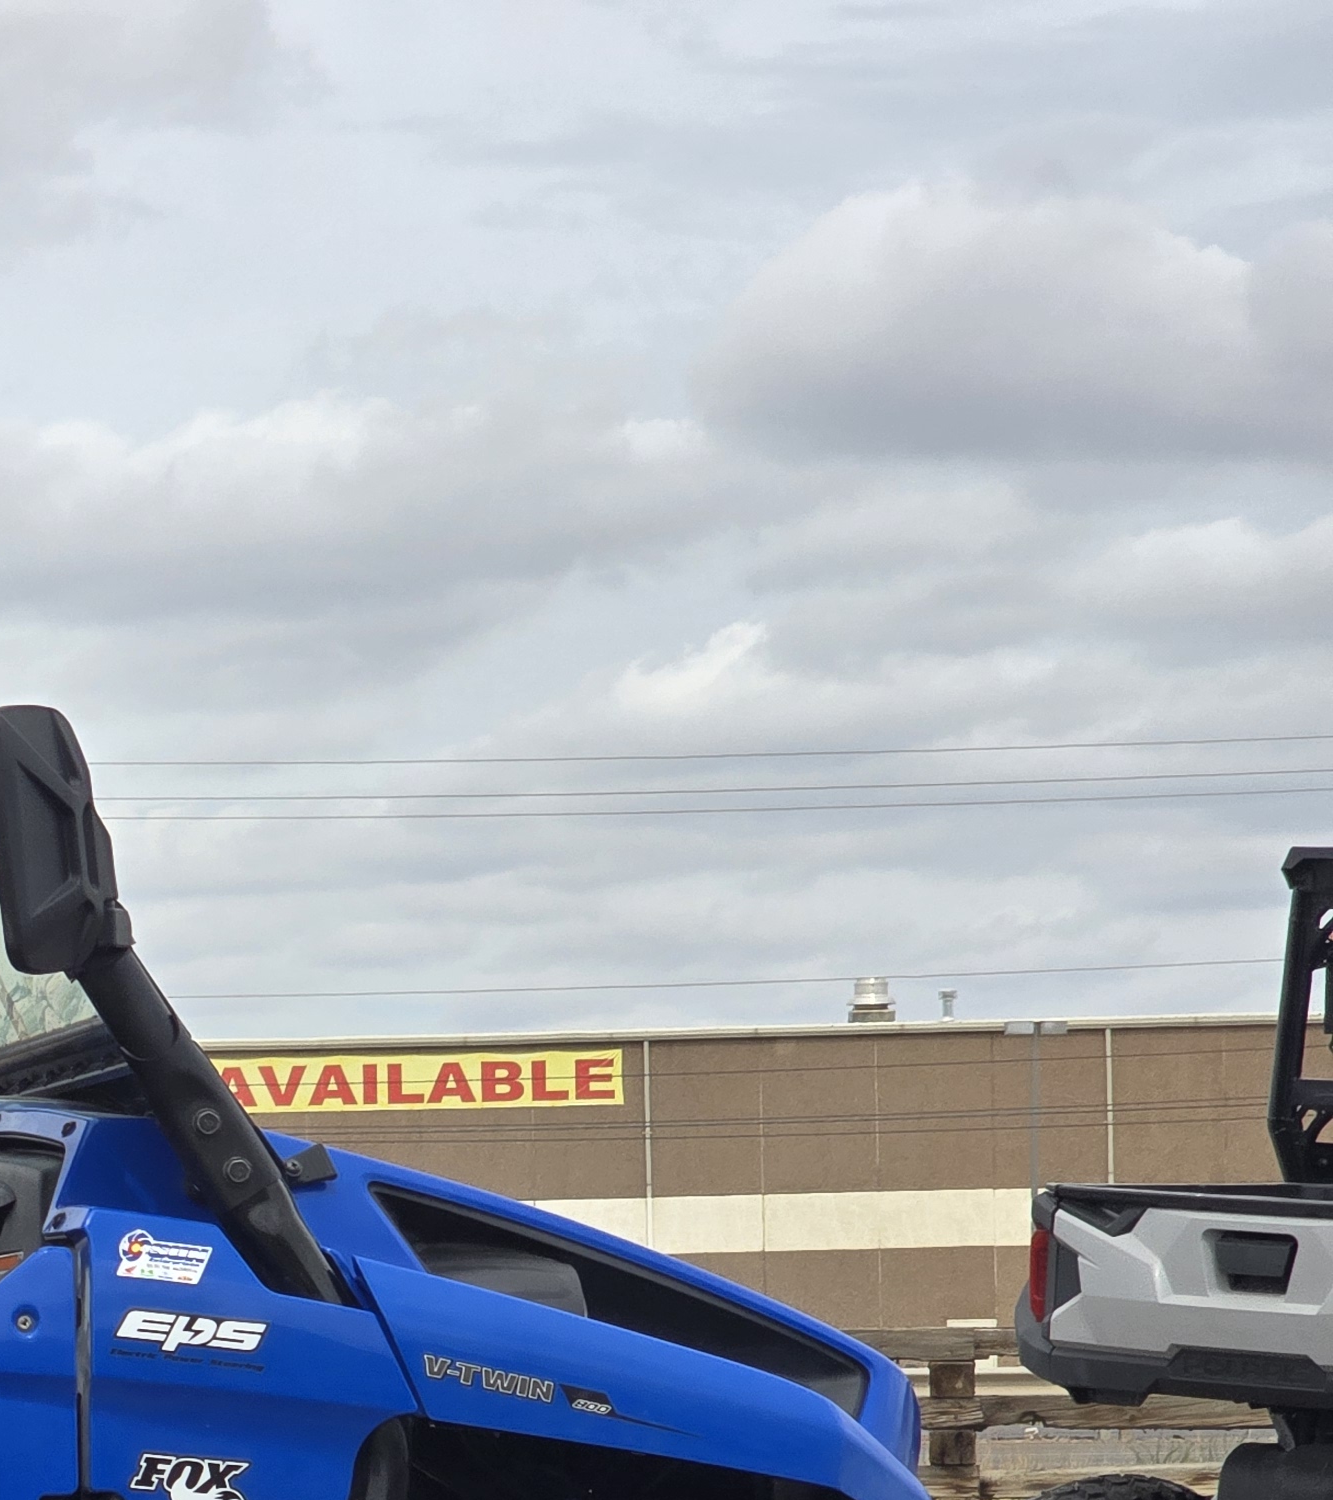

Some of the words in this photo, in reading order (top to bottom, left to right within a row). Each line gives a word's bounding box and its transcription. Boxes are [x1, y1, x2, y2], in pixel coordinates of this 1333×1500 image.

[220, 1058, 616, 1107] AVAILABLE
[163, 1353, 204, 1364] Power
[209, 1359, 265, 1373] Steering
[423, 1354, 554, 1404] V-TWIN
